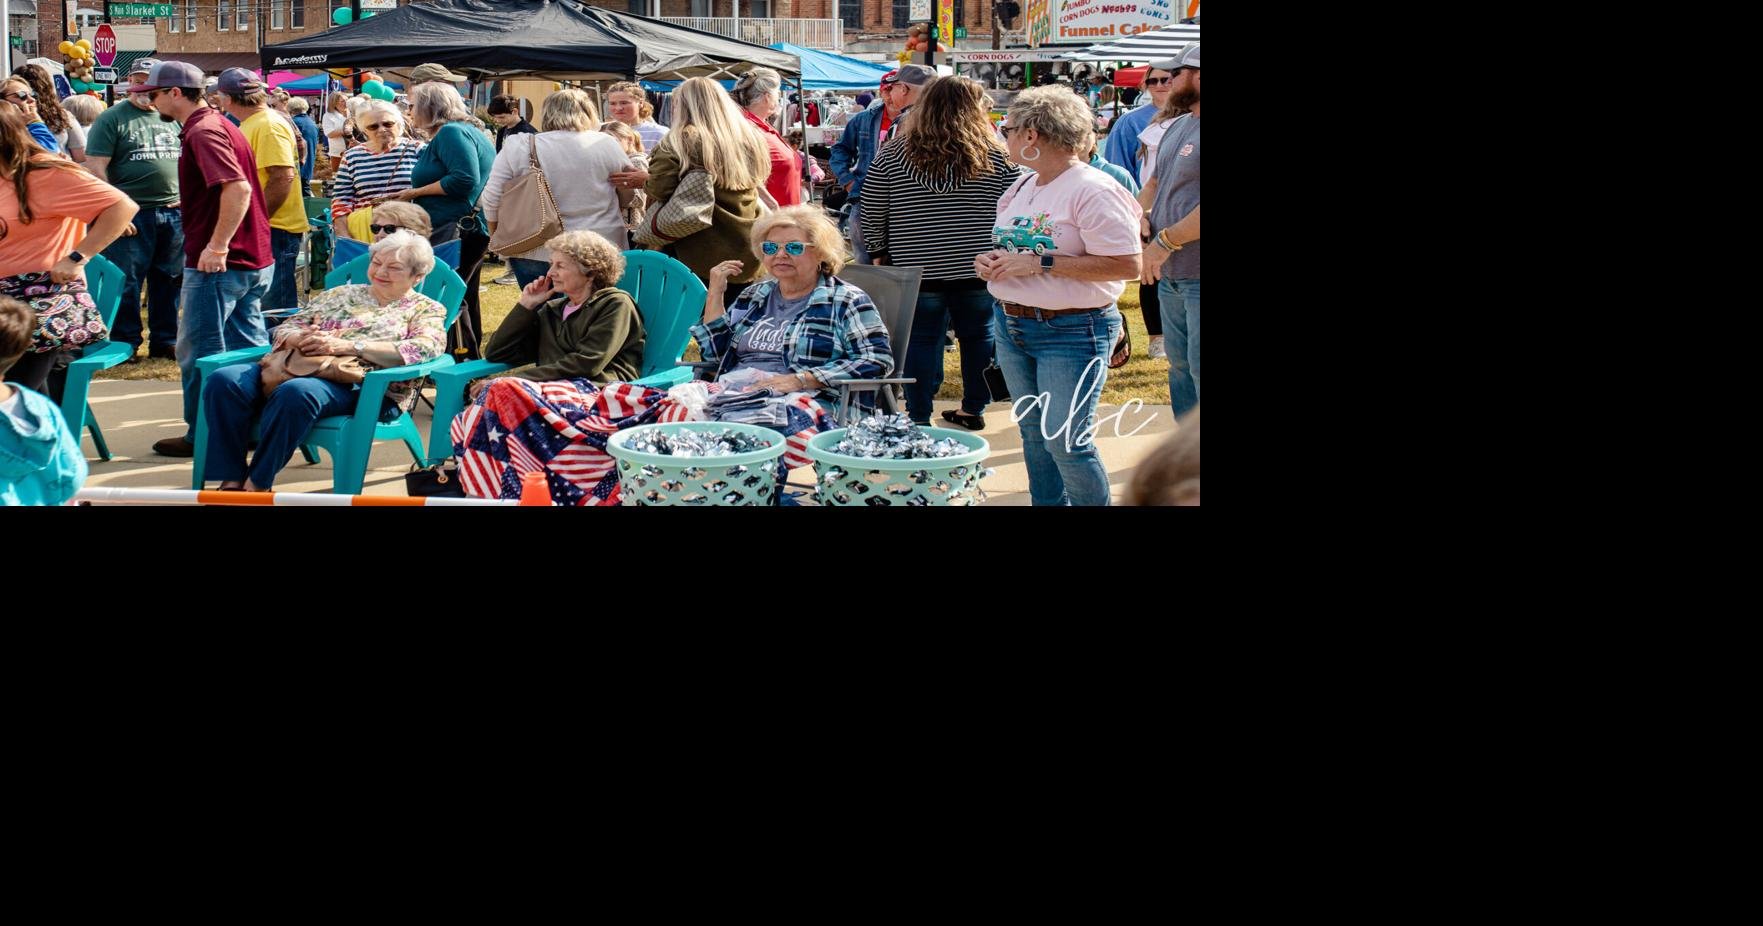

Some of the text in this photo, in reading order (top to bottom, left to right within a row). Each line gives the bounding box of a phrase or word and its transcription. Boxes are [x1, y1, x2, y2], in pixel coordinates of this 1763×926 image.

[160, 6, 169, 15] St
[1059, 6, 1100, 23] CORN DOGS
[1060, 24, 1115, 37] Funnel
[1119, 23, 1169, 36] Cake
[95, 37, 115, 53] STOP
[273, 54, 328, 66] Academy
[130, 152, 156, 161] JOHN
